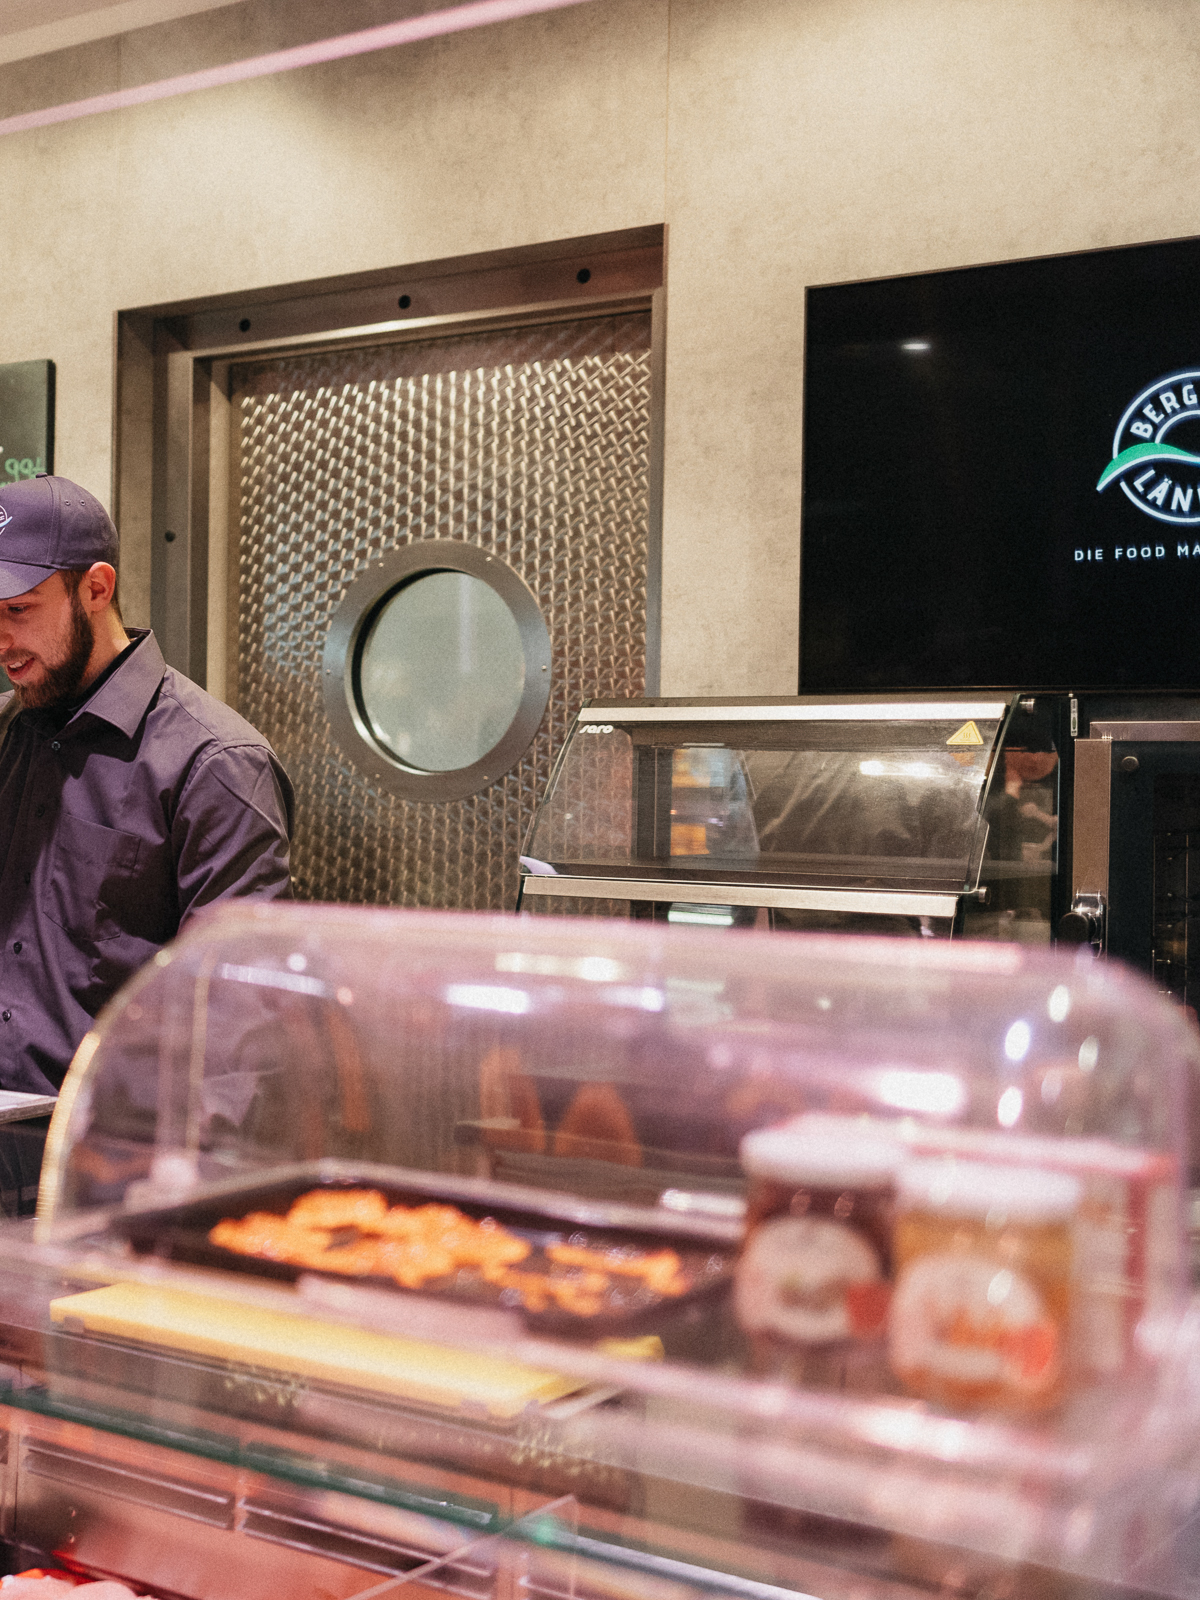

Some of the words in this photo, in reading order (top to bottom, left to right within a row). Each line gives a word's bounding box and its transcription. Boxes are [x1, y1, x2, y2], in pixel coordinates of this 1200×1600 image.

[1130, 384, 1199, 438] BERG
[1133, 469, 1200, 512] LÄN
[1074, 549, 1104, 561] DIE
[1114, 546, 1166, 559] FOOD
[579, 724, 614, 734] saro
